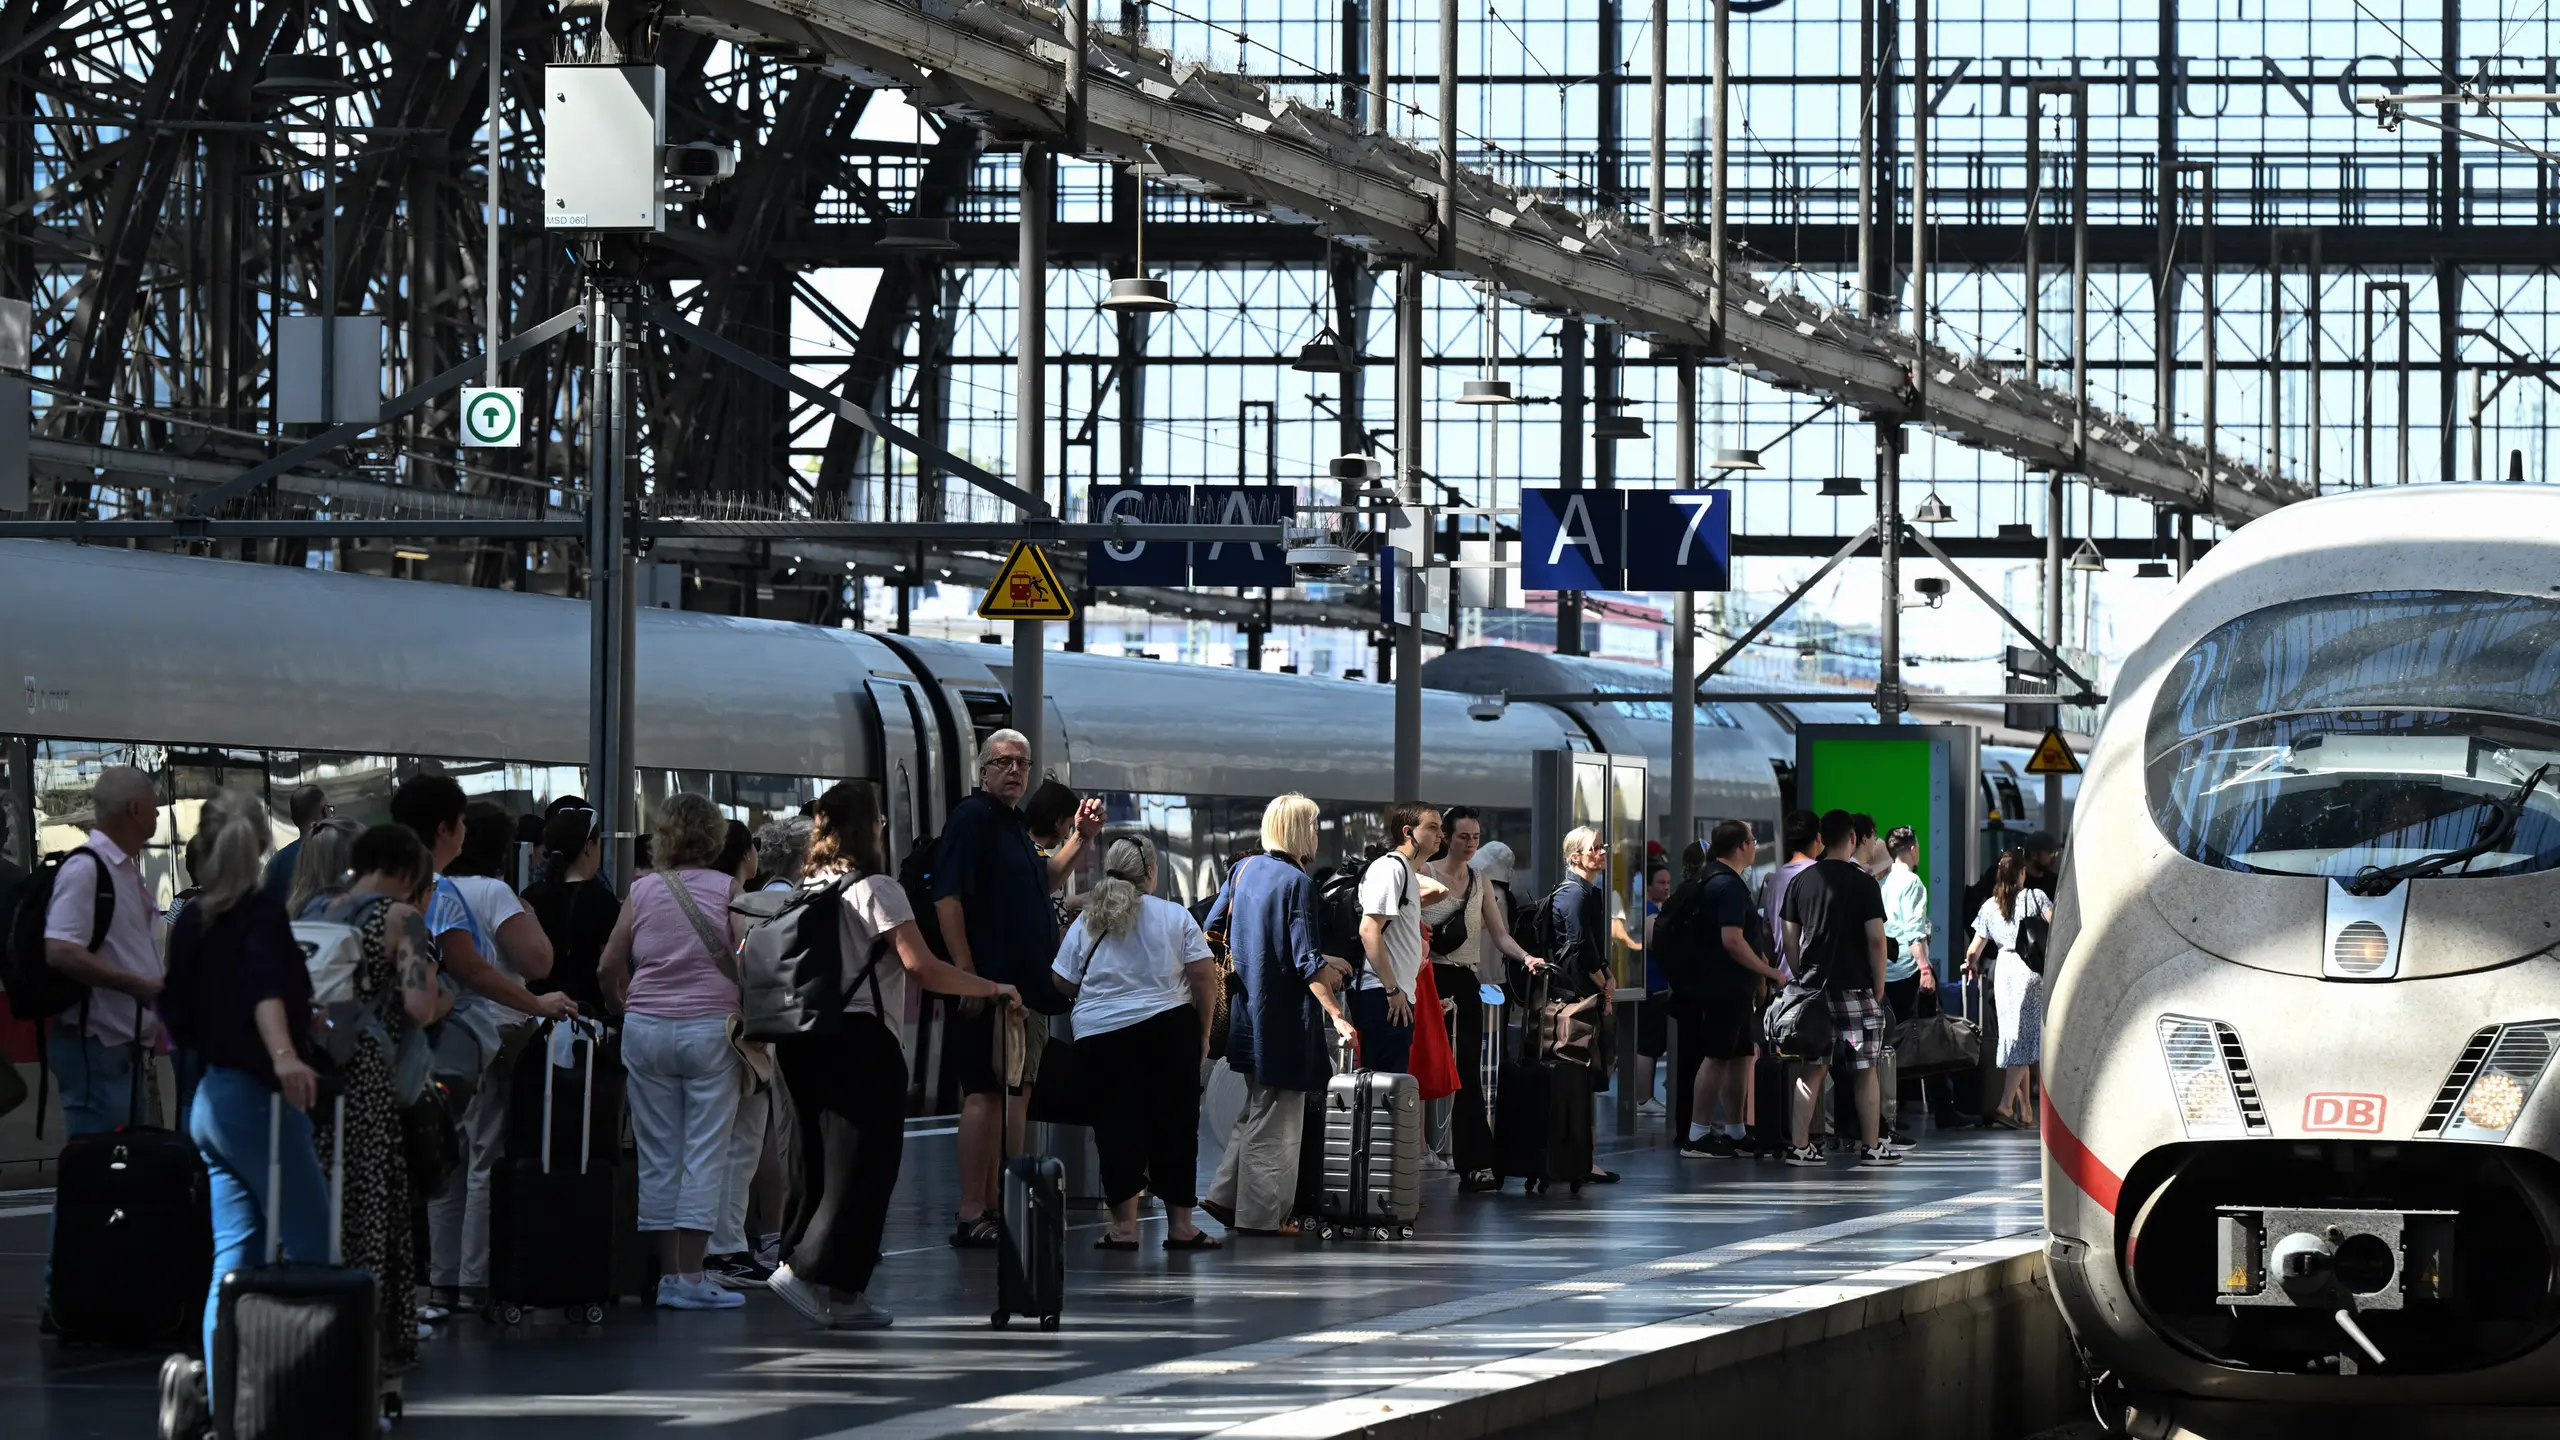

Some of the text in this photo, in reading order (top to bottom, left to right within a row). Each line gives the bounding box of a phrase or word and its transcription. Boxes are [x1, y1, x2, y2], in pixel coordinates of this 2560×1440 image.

[1927, 54, 2408, 118] ZEITUNG
[546, 216, 586, 225] MSD 060
[1103, 489, 1264, 562] 6 A
[1547, 494, 1713, 566] A 7
[2311, 1096, 2378, 1128] DB
